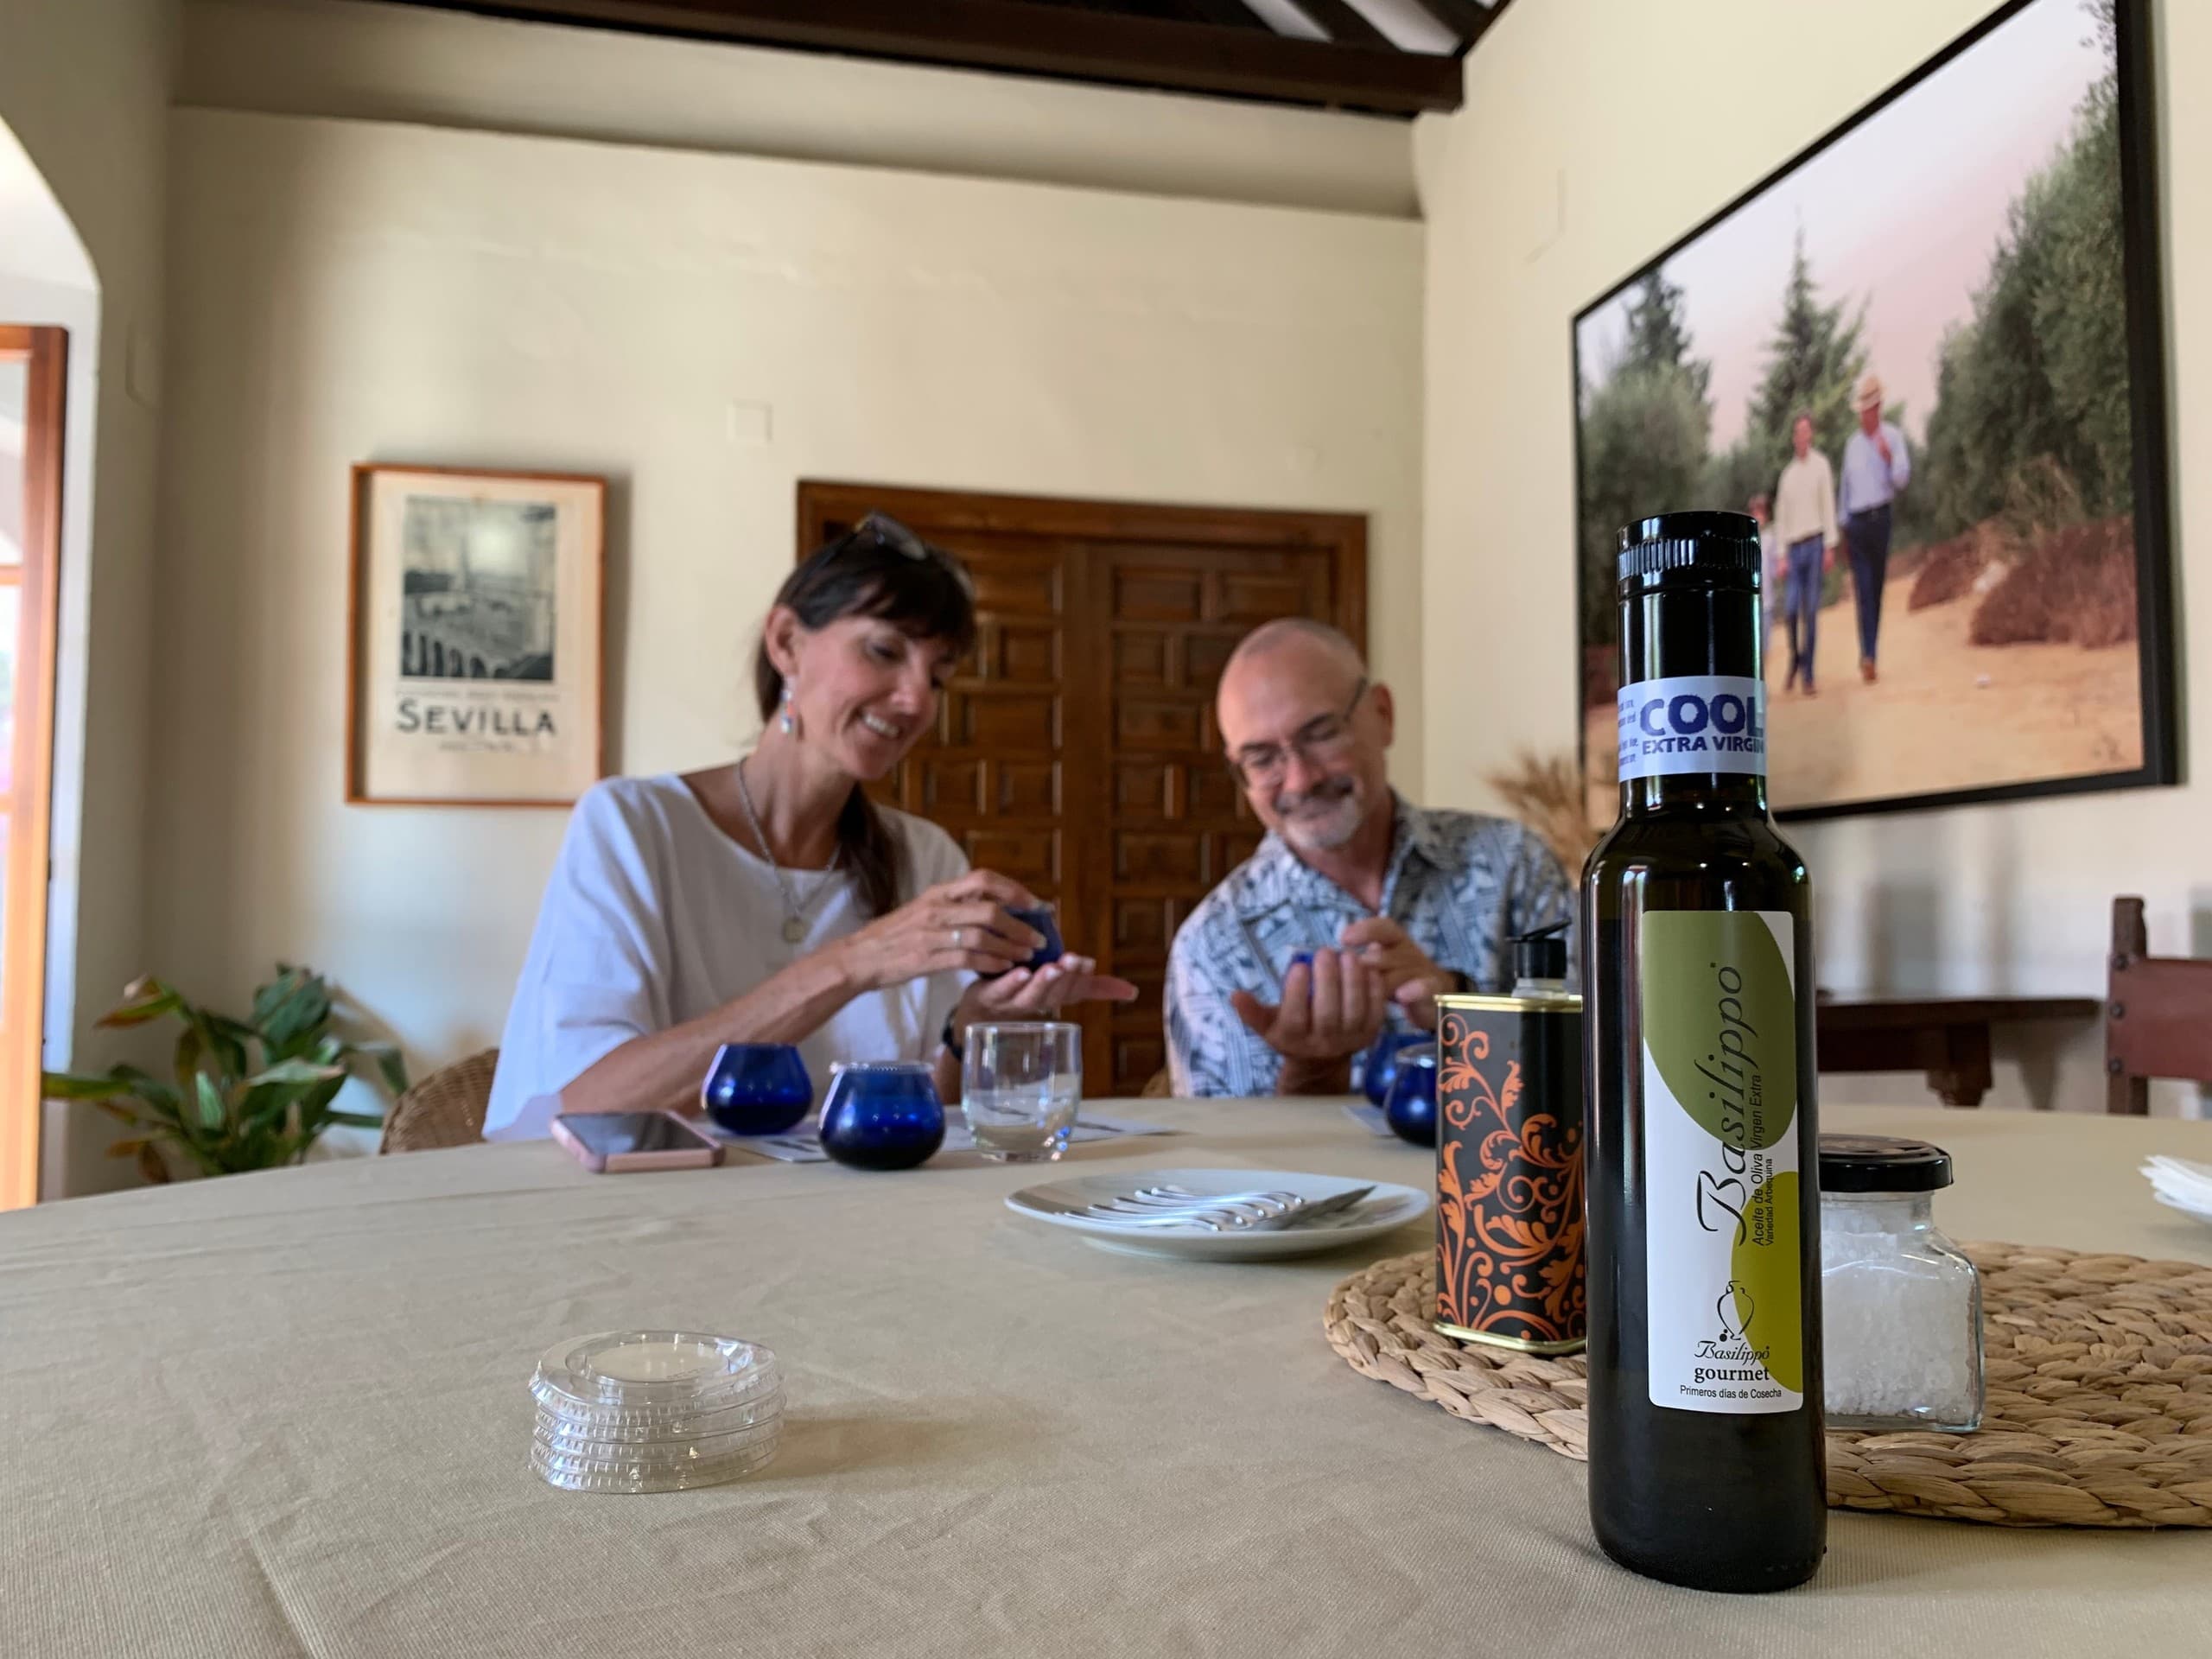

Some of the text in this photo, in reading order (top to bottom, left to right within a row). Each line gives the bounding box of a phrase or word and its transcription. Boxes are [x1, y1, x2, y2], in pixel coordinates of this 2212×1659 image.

[397, 698, 556, 734] SEVILLA
[1640, 694, 1764, 736] COOL
[1643, 736, 1707, 754] EXTRA
[1694, 964, 1758, 1246] Basilippo
[1749, 1074, 1764, 1246] Aceite de Oliva Virgen Extra
[1764, 1206, 1774, 1246] Variedad
[1680, 1384, 1782, 1399] Primeros días de Cosecha
[1694, 1367, 1770, 1383] gourmet
